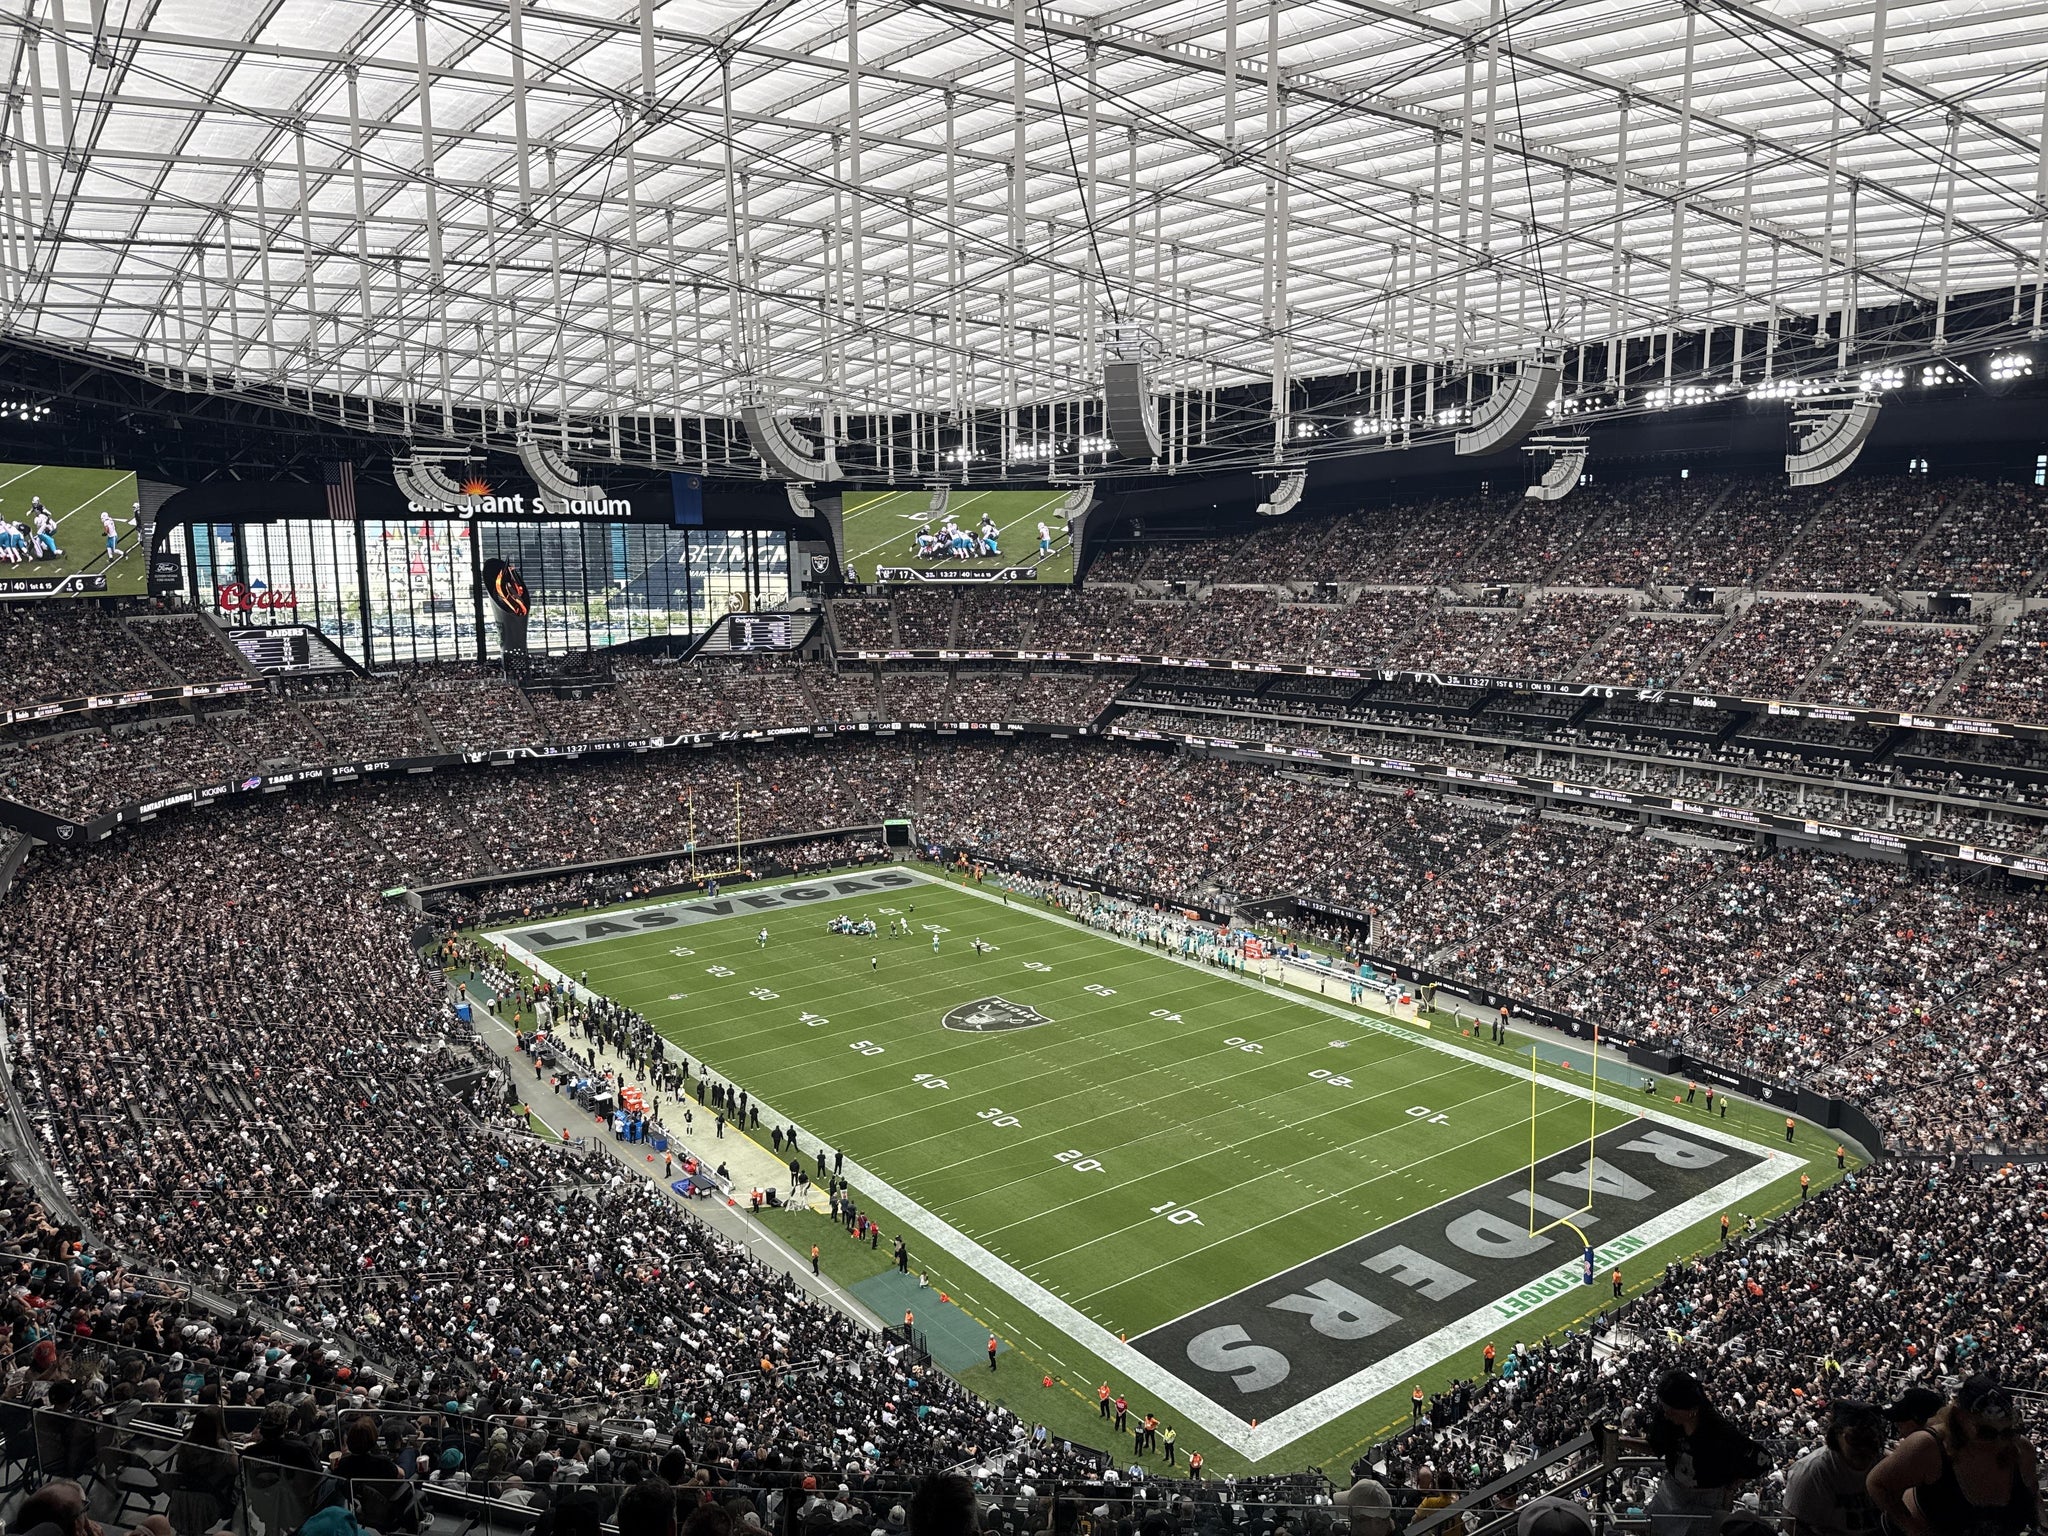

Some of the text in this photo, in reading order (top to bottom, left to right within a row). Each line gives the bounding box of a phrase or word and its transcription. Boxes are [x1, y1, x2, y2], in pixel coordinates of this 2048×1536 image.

[899, 570, 909, 579] 17
[14, 582, 25, 590] 40
[75, 580, 84, 591] 6
[218, 582, 298, 611] Coors
[230, 607, 294, 626] LIGHT
[266, 629, 304, 638] RAIDERS
[1469, 677, 1490, 687] 13:27
[1560, 685, 1569, 693] 40
[1605, 688, 1613, 699] 6
[1693, 696, 1717, 708] Modelo
[1780, 707, 1800, 717] Modelo
[1913, 718, 1935, 728] Modelo
[767, 727, 808, 735] SCOREBOARD
[567, 744, 587, 753] 13:27
[693, 735, 700, 743] 6
[140, 800, 165, 814] FANTASY
[165, 793, 193, 807] LEADERS
[201, 785, 227, 797] KICKING
[268, 774, 294, 784] T.BASS
[305, 770, 322, 778] FGM
[332, 767, 338, 775] 3
[339, 766, 355, 774] FGA
[374, 762, 389, 770] PTS
[1564, 786, 1582, 796] Modelo
[1684, 803, 1704, 814] Modelo
[1820, 827, 1841, 838] Modelo
[1976, 851, 2002, 864] Modelo
[527, 912, 679, 947] LAS
[682, 873, 914, 915] VEGAS
[1312, 903, 1326, 911] 13:27
[669, 946, 695, 957] 10
[705, 965, 736, 978] 20
[1023, 961, 1052, 972] 40
[749, 987, 780, 1001] 30
[1083, 983, 1117, 996] 50
[799, 1012, 829, 1027] 40
[1149, 1008, 1184, 1024] 40
[1354, 1016, 1427, 1042] KICKOFF
[849, 1040, 885, 1056] 50
[1223, 1036, 1262, 1053] 30
[911, 1072, 946, 1090] 40
[1307, 1068, 1351, 1087] 20
[976, 1107, 1019, 1129] 30
[1404, 1105, 1448, 1125] 10
[1053, 1149, 1102, 1173] 20
[1150, 1201, 1200, 1226] 10
[1186, 1130, 1729, 1394] RAIDERS
[1493, 1269, 1582, 1319] FORGET
